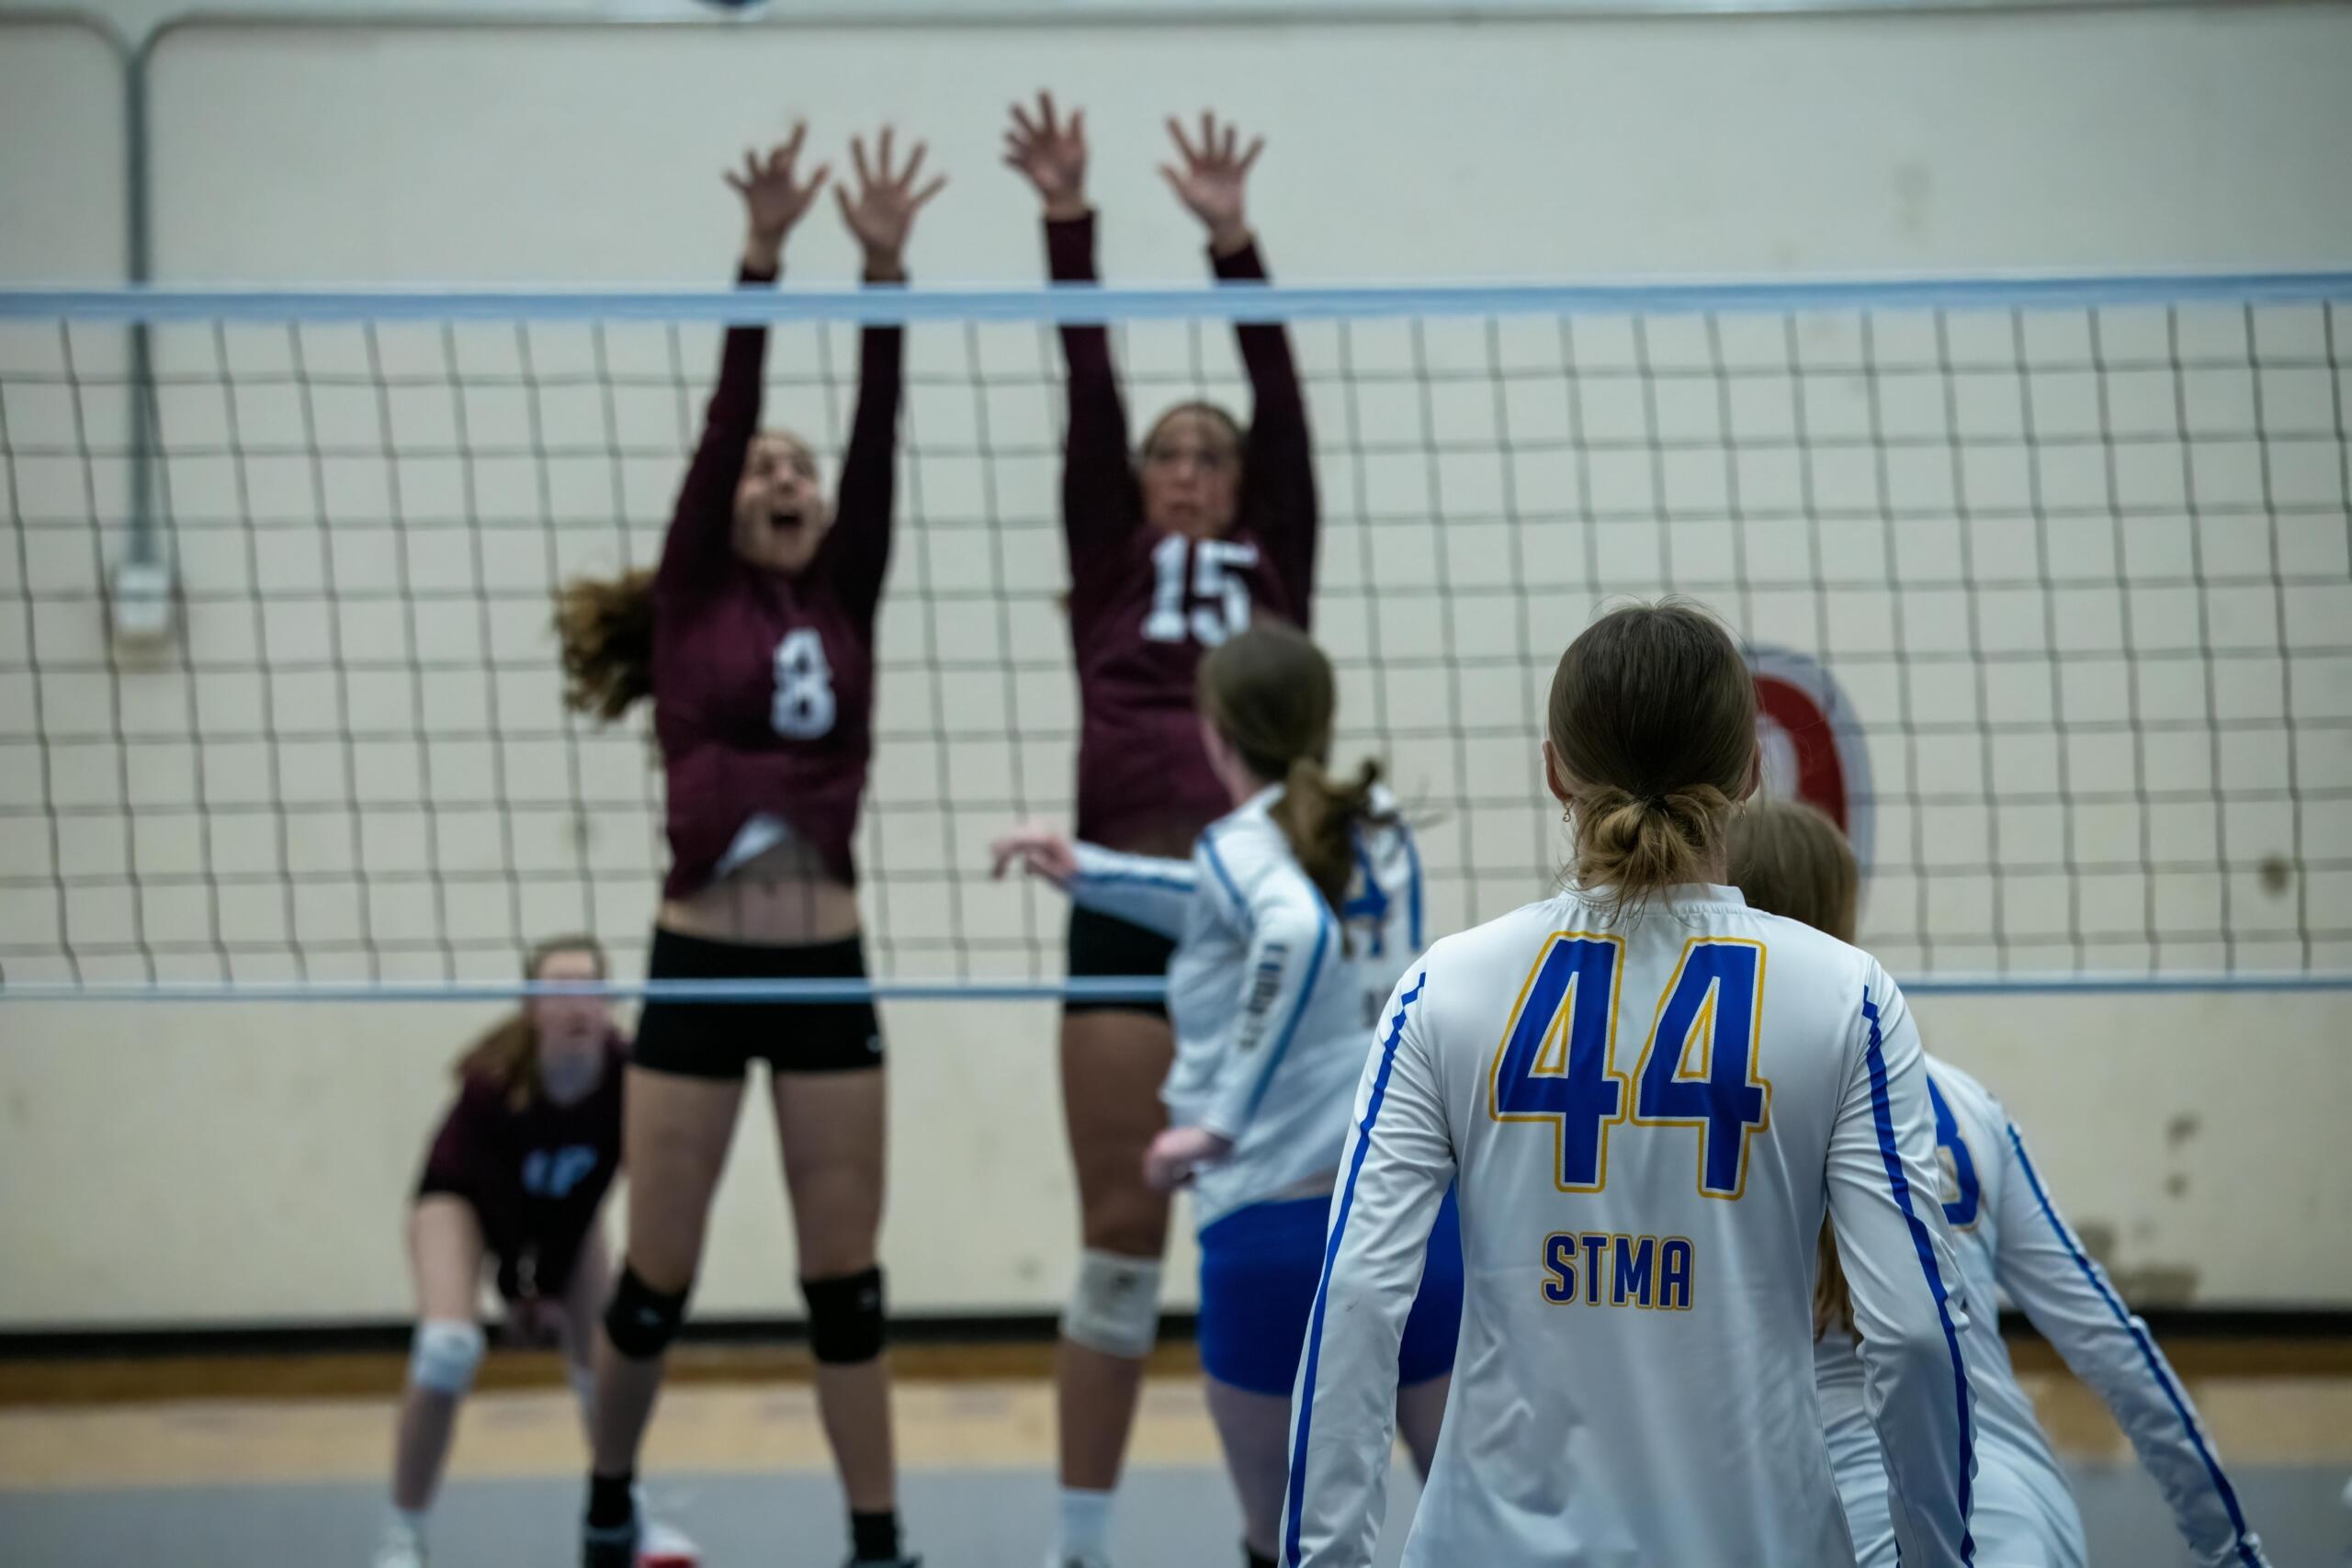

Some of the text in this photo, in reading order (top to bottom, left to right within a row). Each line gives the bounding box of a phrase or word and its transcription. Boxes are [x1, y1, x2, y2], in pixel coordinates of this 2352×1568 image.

[1139, 533, 1259, 645] 15
[771, 626, 837, 739] 8
[1489, 931, 1771, 1201] 44
[1541, 1231, 1695, 1311] STMA
